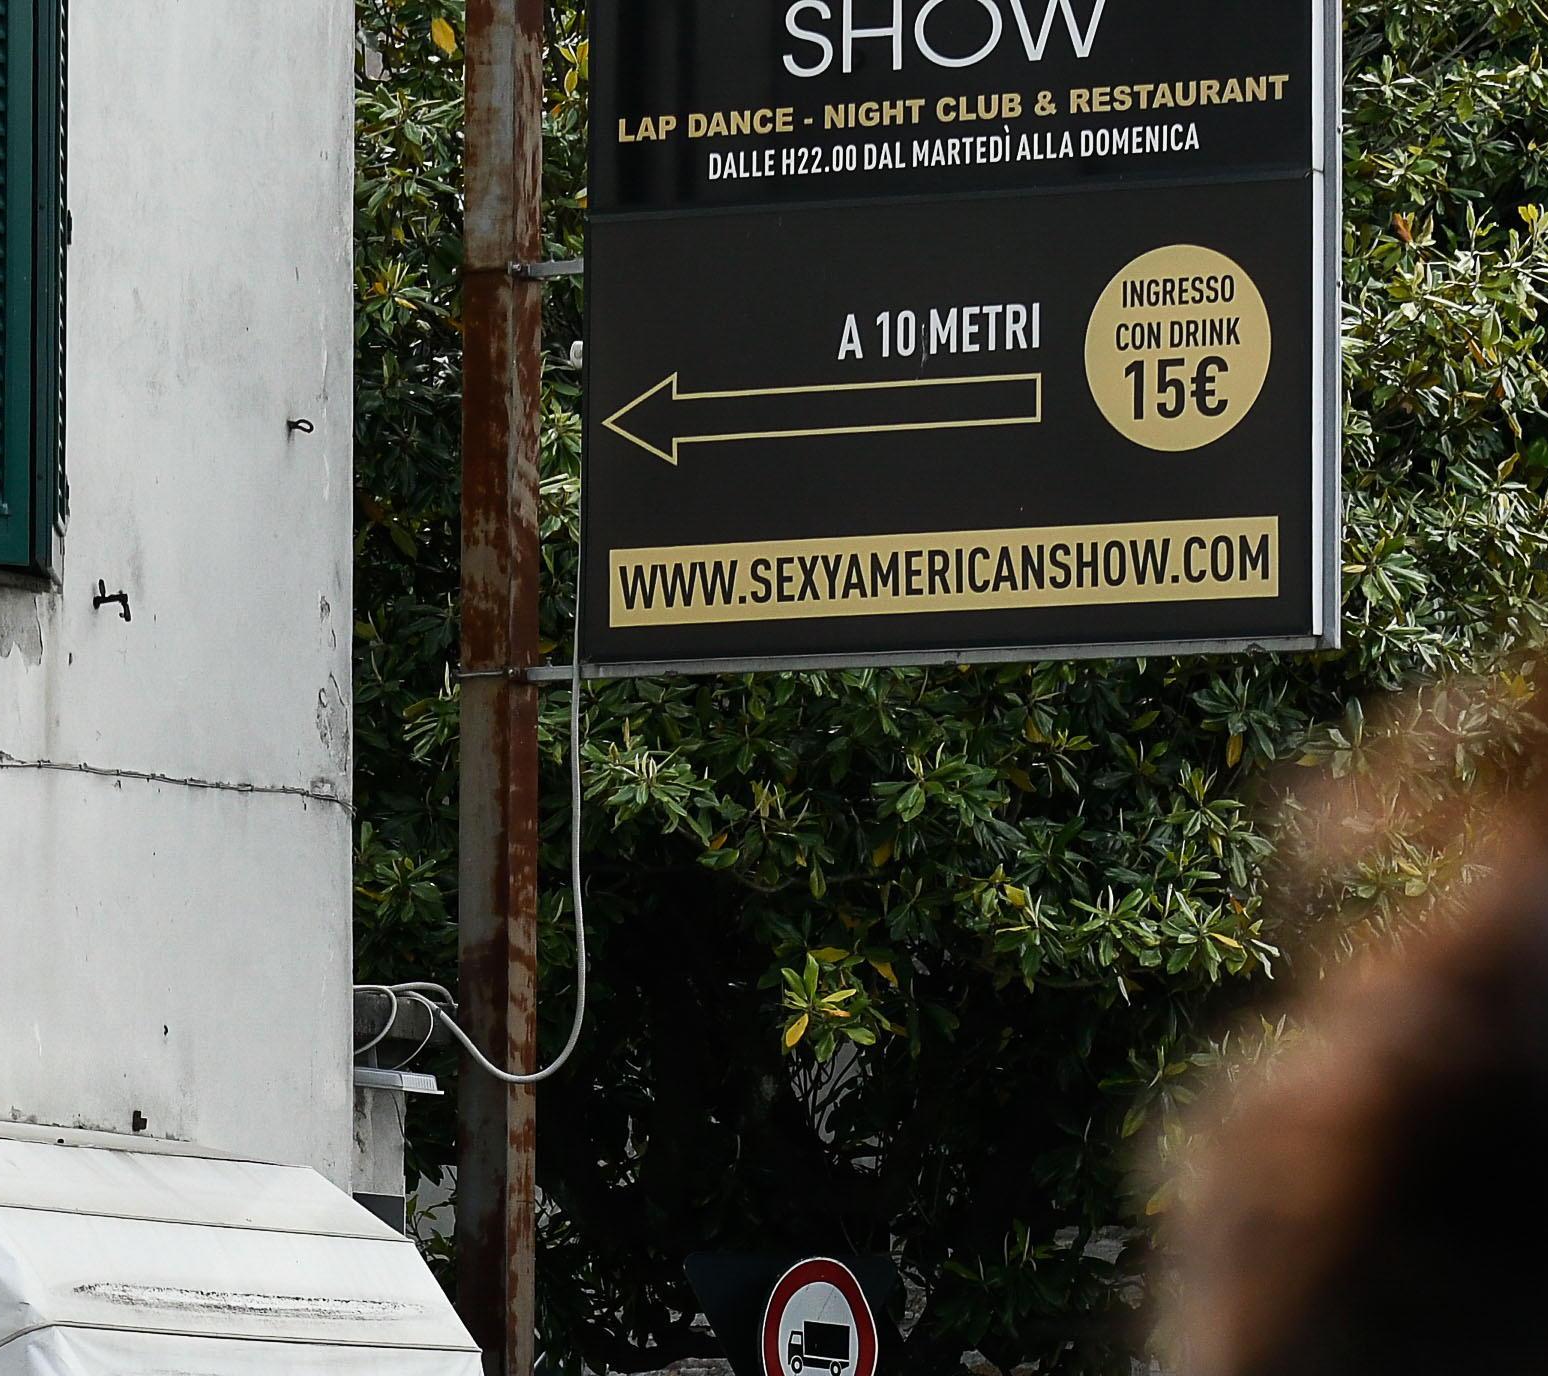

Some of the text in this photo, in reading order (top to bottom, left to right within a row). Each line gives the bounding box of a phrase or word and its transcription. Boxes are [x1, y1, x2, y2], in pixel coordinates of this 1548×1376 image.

[782, 0, 1104, 77] SHOW
[618, 116, 677, 143] LAP
[687, 107, 794, 138] DANCE
[824, 98, 926, 130] NIGHT
[936, 93, 1022, 122] CLUB
[1034, 90, 1058, 116] &
[1069, 74, 1290, 114] RESTAURANT
[708, 122, 1200, 180] DALLE H22.00 DAL MARTEDÌ ALLA DOMENICA
[1121, 274, 1235, 309] INGRESSO
[837, 302, 1041, 361] A 10 METRI
[1115, 317, 1241, 352] CON DRINK
[1122, 354, 1230, 422] 15€
[618, 533, 1272, 611] WWW.SEXYAMERICANSHOW.COM
